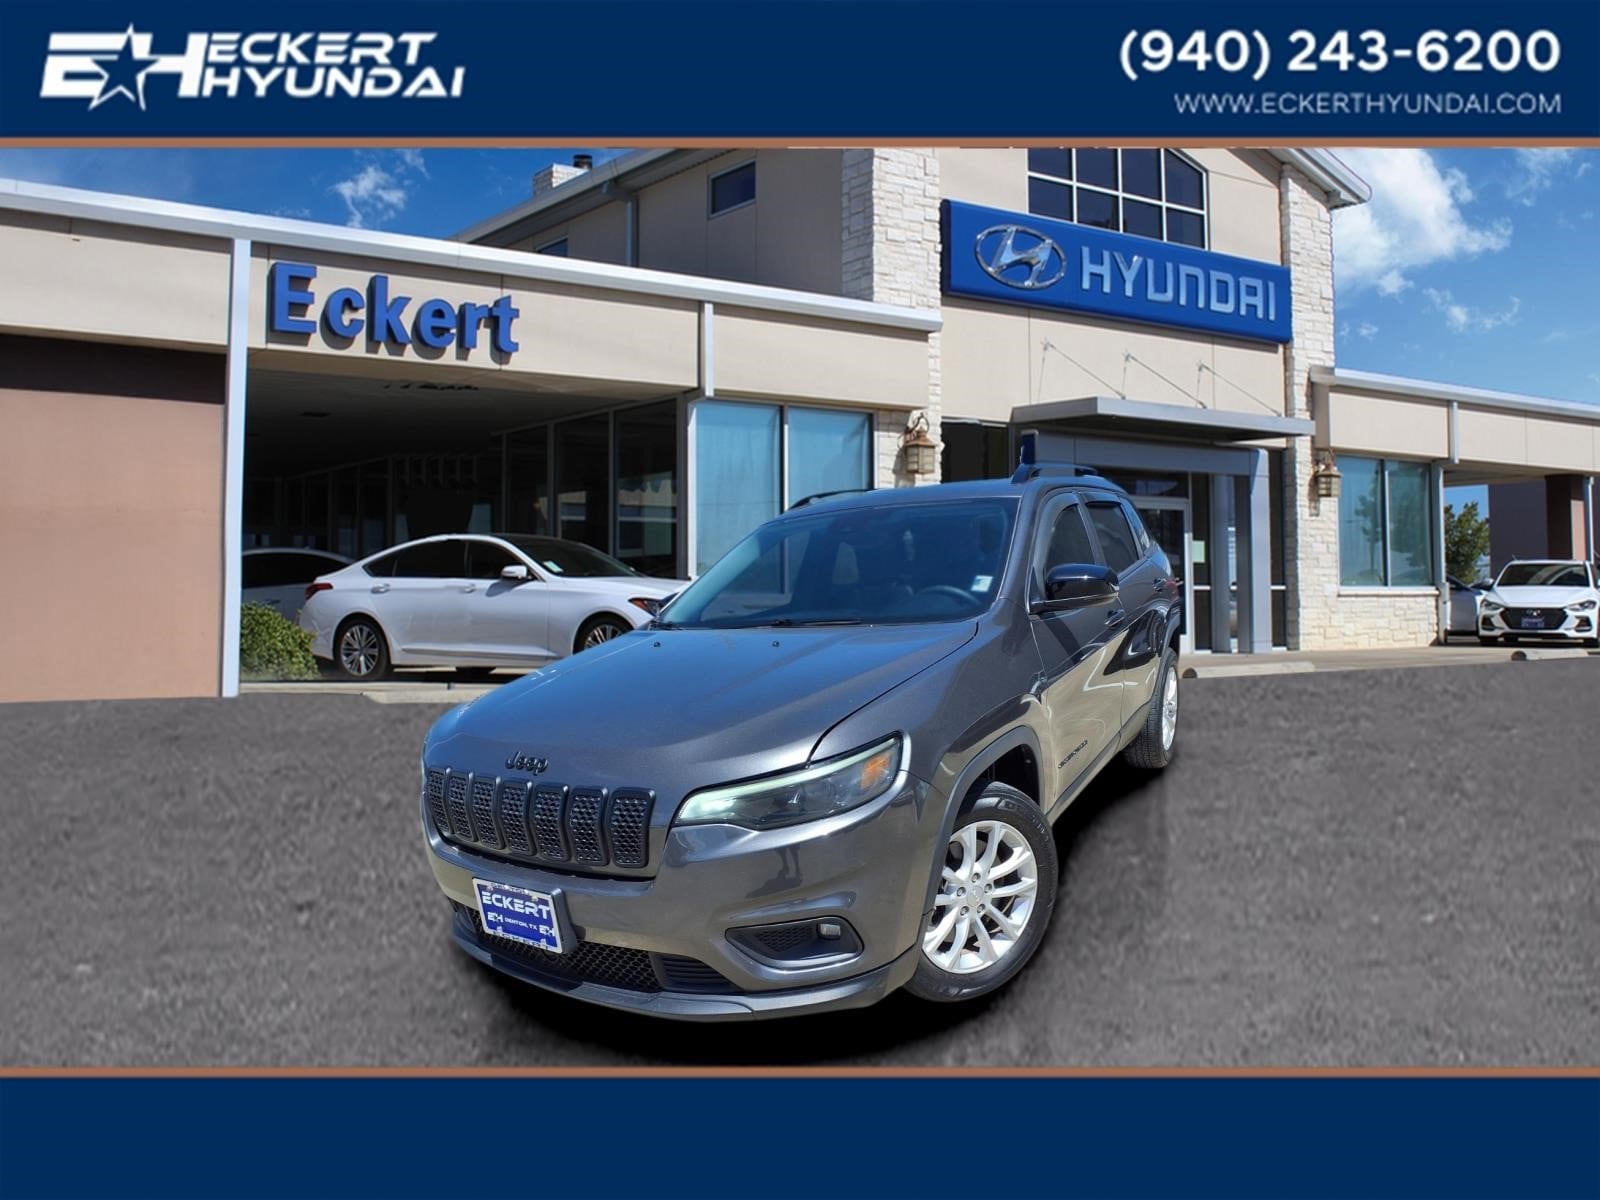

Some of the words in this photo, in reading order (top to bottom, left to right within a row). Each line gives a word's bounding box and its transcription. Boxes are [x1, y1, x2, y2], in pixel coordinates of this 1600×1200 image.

[271, 261, 520, 353] Eckert
[1081, 245, 1276, 321] HYUNDAI
[505, 751, 549, 776] Jeep
[481, 890, 550, 919] ECKERT
